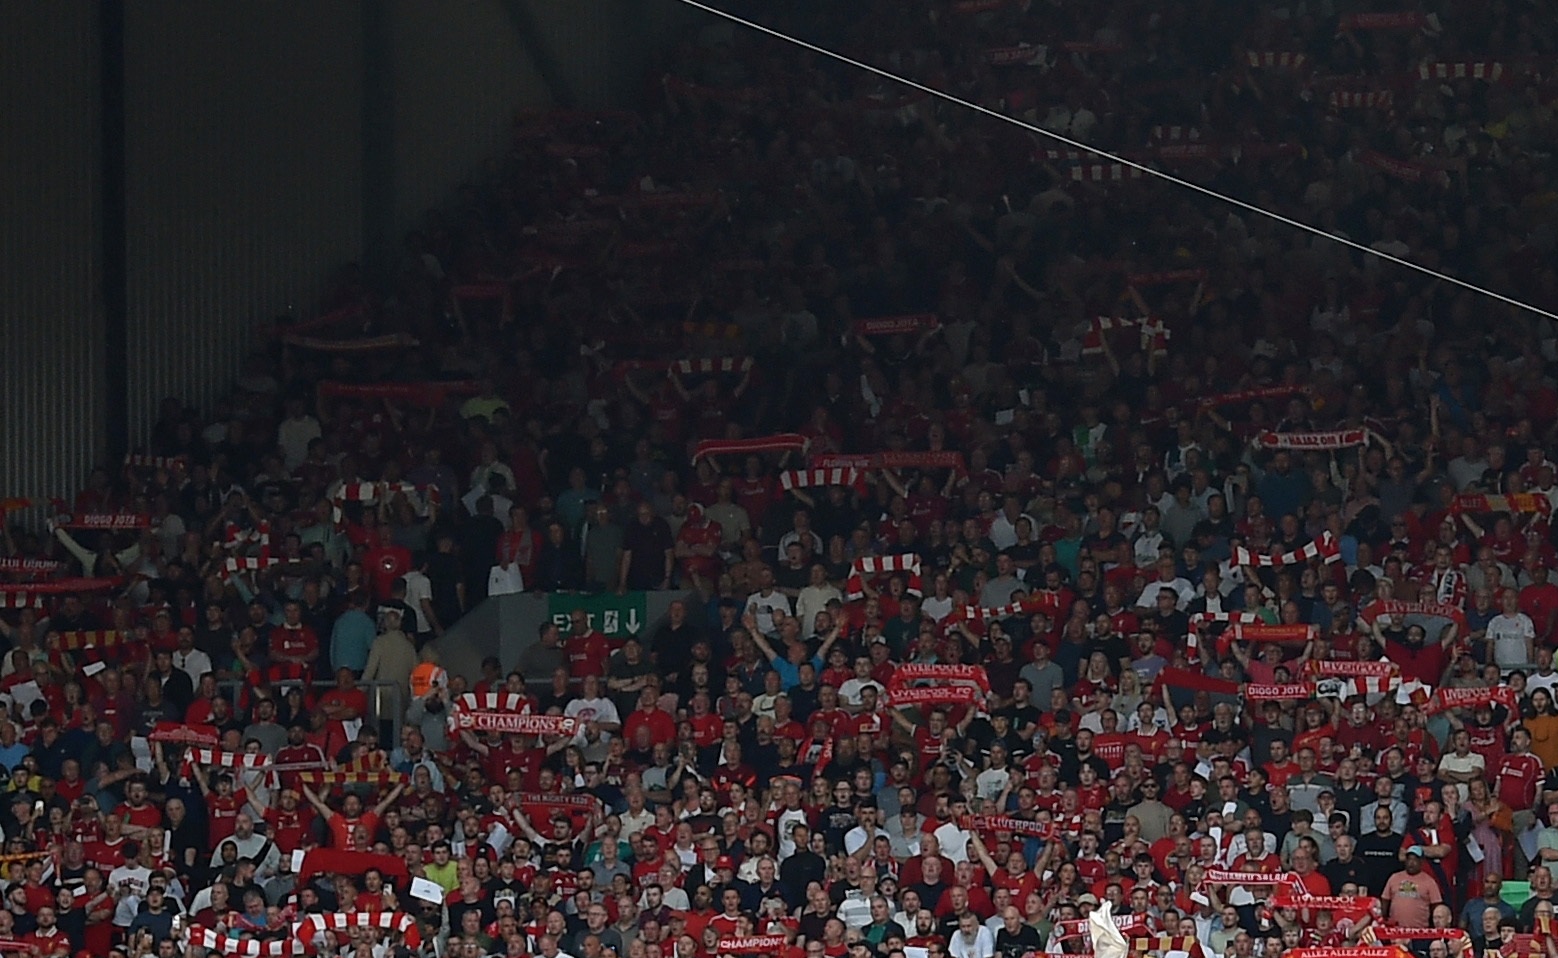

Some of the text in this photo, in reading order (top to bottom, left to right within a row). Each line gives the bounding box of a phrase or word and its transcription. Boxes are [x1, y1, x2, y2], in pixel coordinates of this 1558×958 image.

[84, 514, 136, 526] DIOGO JOTA
[553, 613, 596, 632] EXT
[902, 663, 975, 676] LIVERPOOL FC
[1248, 685, 1307, 697] DIOGO JOTA
[1443, 687, 1509, 701] LIVERPOOL FC
[477, 715, 557, 731] CHAMPIONS
[990, 817, 1048, 834] LIVERPOOL
[1210, 870, 1289, 882] MOHAMED SALAH
[1291, 894, 1355, 905] LIVERPOOL
[1384, 926, 1455, 936] LIVERPOOL FC
[1330, 949, 1358, 958] ALLEZ
[1360, 948, 1389, 958] ALLEZ
